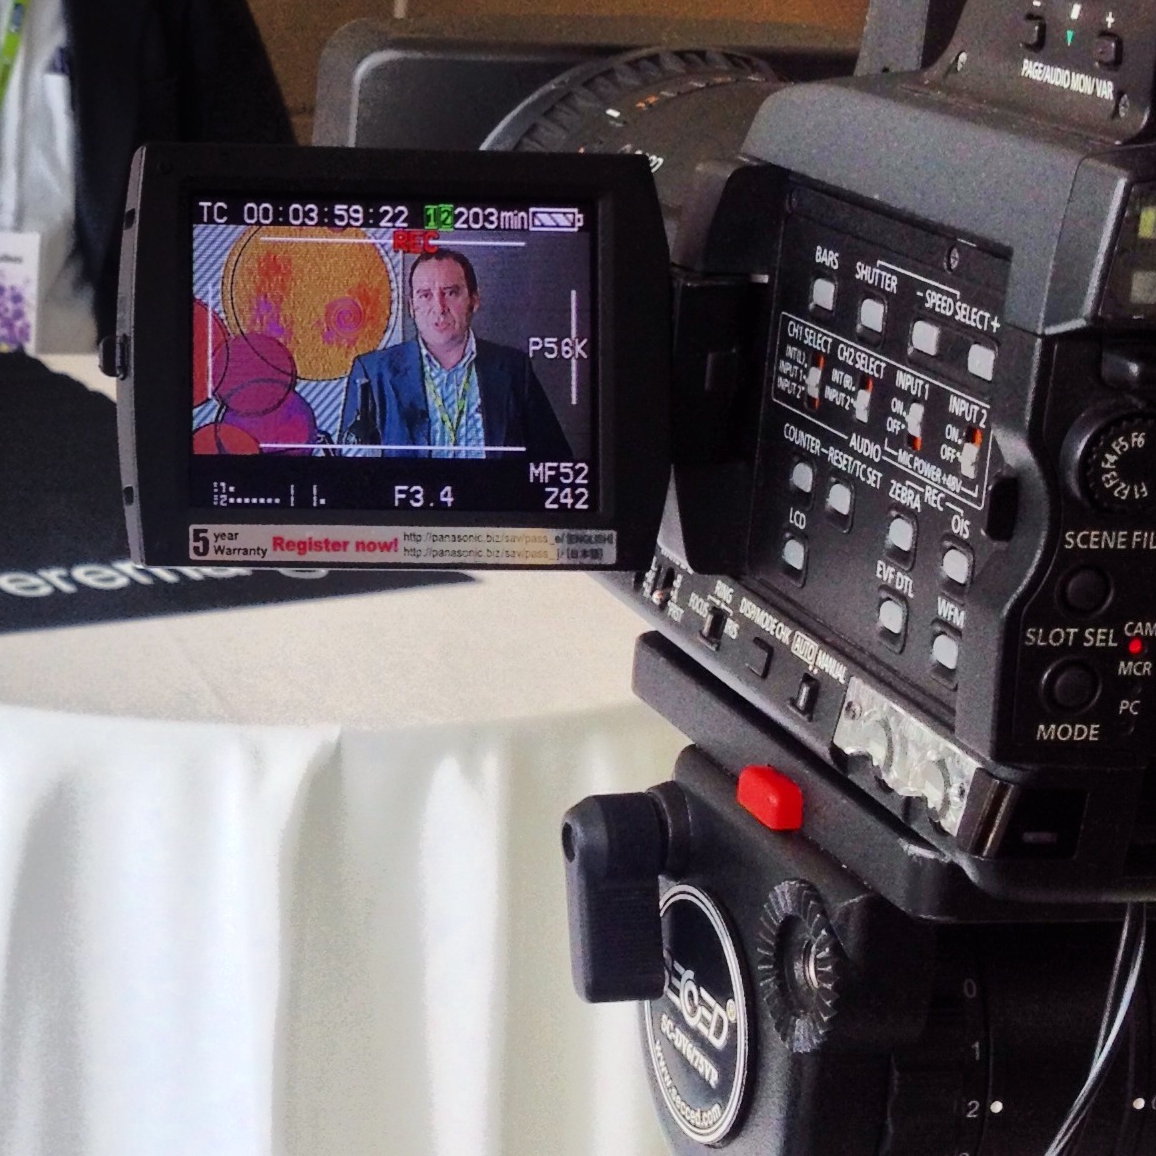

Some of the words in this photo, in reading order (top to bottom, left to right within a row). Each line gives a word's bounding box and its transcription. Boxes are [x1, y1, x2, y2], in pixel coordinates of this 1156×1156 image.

[1021, 58, 1071, 90] PAGE/AUDIO
[198, 201, 228, 224] TC
[243, 202, 409, 228] 00:03:59:22
[453, 206, 528, 230] 203min
[393, 230, 440, 253] REC
[815, 245, 839, 270] BARS
[855, 260, 898, 294] SHUTTER
[924, 288, 955, 317] SPEED
[954, 300, 991, 332] SELECT
[787, 320, 803, 341] CH1
[803, 327, 833, 354] SELECT
[778, 359, 799, 379] INPUT
[837, 343, 855, 366] CH2
[854, 351, 887, 380] SELECT
[777, 376, 798, 395] INPUT
[824, 385, 847, 407] INPUT
[895, 369, 924, 398] INPUT
[924, 383, 930, 401] 1
[890, 397, 904, 415] ON
[948, 394, 980, 424] INPUT
[979, 409, 988, 429] 2
[886, 416, 902, 435] OFF
[945, 423, 959, 443] ON
[783, 422, 821, 457] COUNTER
[849, 432, 882, 463] AUDIO
[1111, 436, 1130, 455] F5
[1130, 432, 1146, 449] F6
[940, 443, 956, 463] OFF
[529, 462, 589, 485] MF52
[897, 448, 914, 469] MIC
[913, 457, 942, 484] POWER
[866, 470, 883, 490] SET
[394, 485, 455, 508] F3.4
[544, 487, 589, 510] Z42
[888, 479, 921, 513] ZEBRA
[924, 486, 945, 512] REC
[789, 507, 806, 530] LCD
[951, 514, 970, 540] OIS
[192, 528, 210, 557] 5
[213, 531, 240, 542] year
[272, 535, 350, 556] Register
[355, 537, 400, 554] now!
[1064, 530, 1128, 550] SCENE
[213, 544, 268, 559] Warranty
[875, 559, 896, 584] EVF
[895, 571, 915, 599] DTL
[714, 579, 734, 605] RING
[688, 592, 710, 619] FOCUS
[937, 596, 966, 629] WFM
[775, 622, 793, 646] CHK
[1025, 627, 1079, 647] SLOT
[1083, 627, 1119, 647] SEL
[793, 635, 815, 662] AUTO
[815, 649, 847, 685] MANUAL
[1118, 660, 1153, 676] MCR
[1119, 700, 1142, 716] PC
[1036, 724, 1101, 741] MODE
[962, 978, 978, 999] 0
[970, 1040, 981, 1061] 1
[965, 1099, 981, 1119] 2
